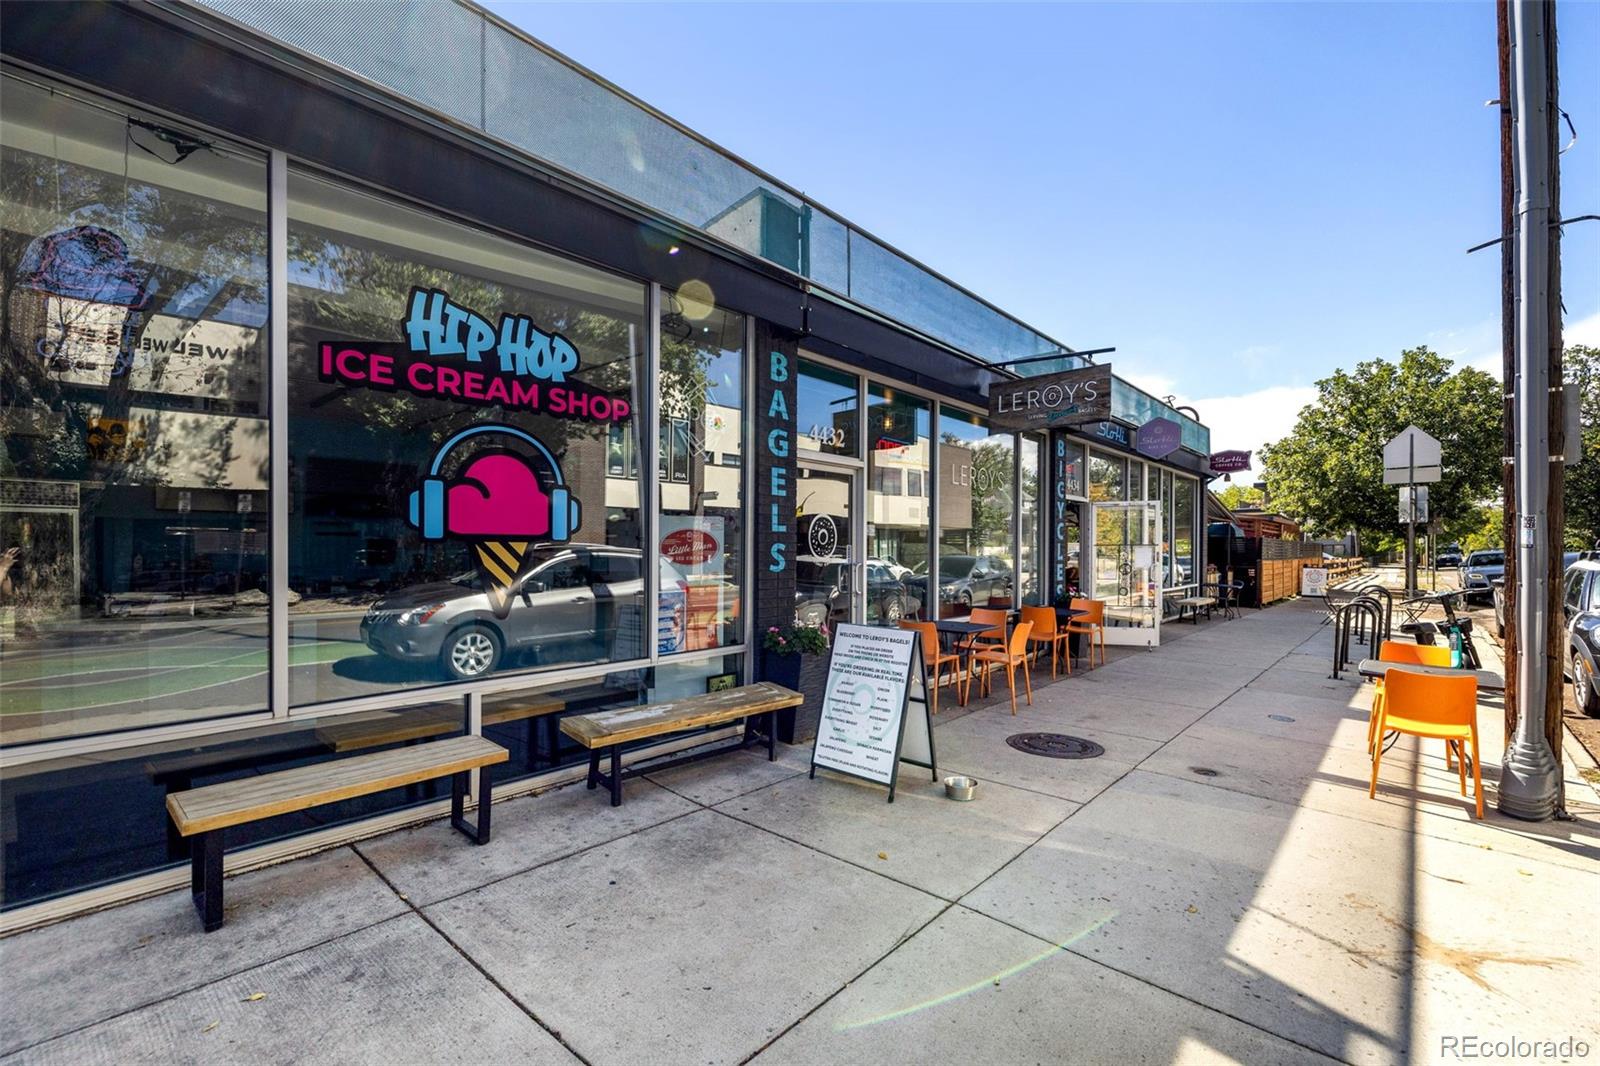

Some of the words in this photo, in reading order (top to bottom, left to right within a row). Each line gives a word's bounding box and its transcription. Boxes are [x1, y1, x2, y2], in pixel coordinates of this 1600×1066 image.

[407, 291, 495, 361] HIP
[498, 317, 577, 382] HOP
[322, 345, 394, 385] ICE
[408, 363, 538, 408] CREAM
[549, 388, 630, 421] SHOP
[998, 381, 1097, 413] LEROY'S
[768, 352, 789, 573] BAGELS
[810, 424, 845, 448] 4432
